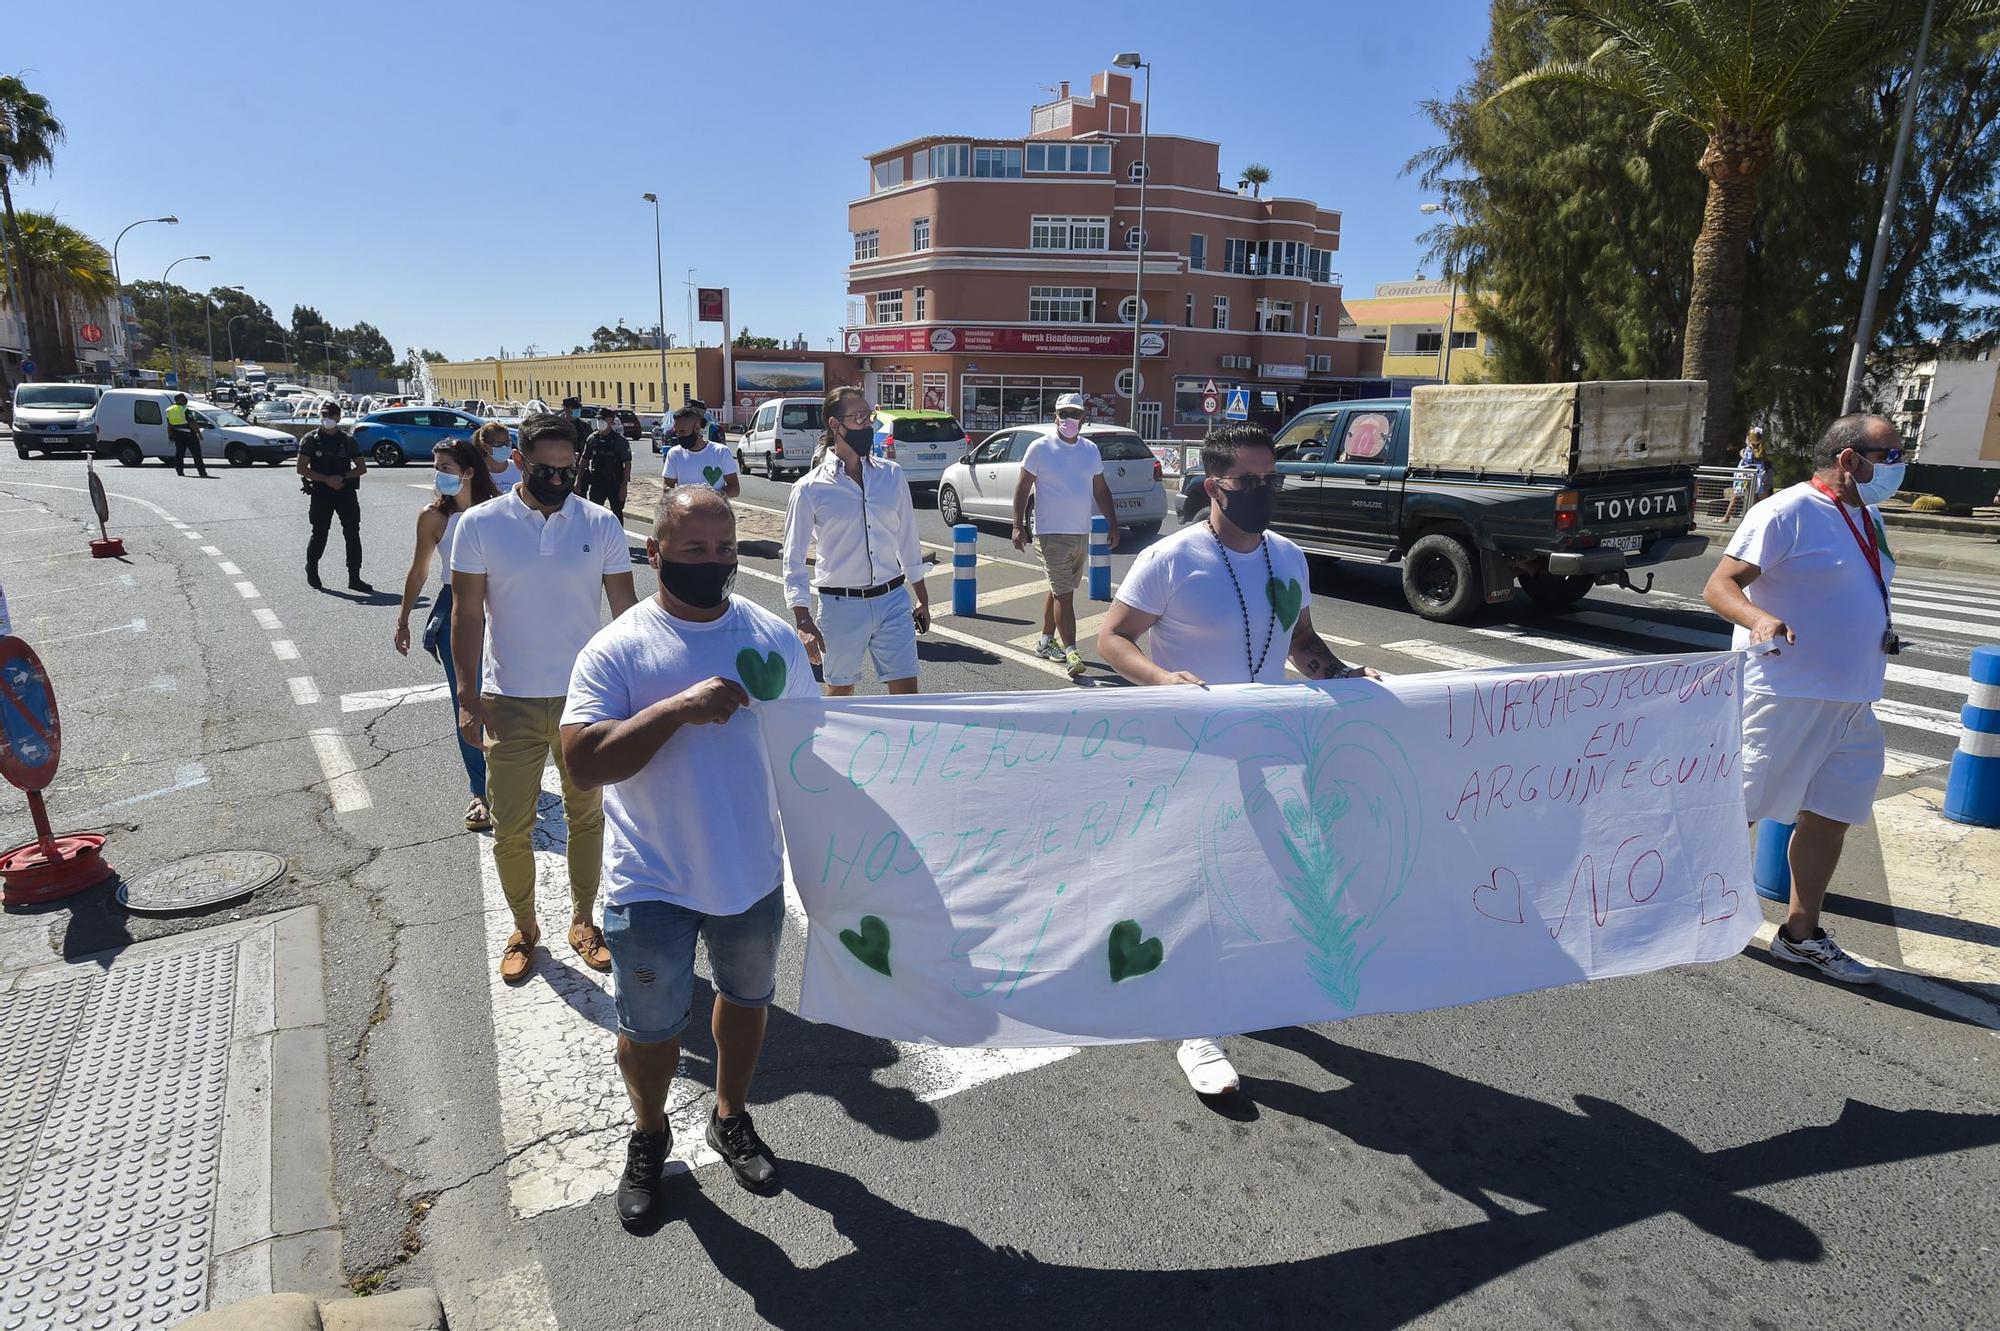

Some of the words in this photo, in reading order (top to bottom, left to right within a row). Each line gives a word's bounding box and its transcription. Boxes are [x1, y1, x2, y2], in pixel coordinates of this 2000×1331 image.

[1022, 333, 1045, 343] Norsk
[1206, 401, 1215, 409] 20
[1594, 494, 1677, 520] TOYOTA
[1446, 662, 1737, 748] INFRAESTRUCTURAS
[789, 708, 1147, 793] COMERCIOS
[1584, 716, 1646, 759] EN
[1550, 834, 1664, 940] NO
